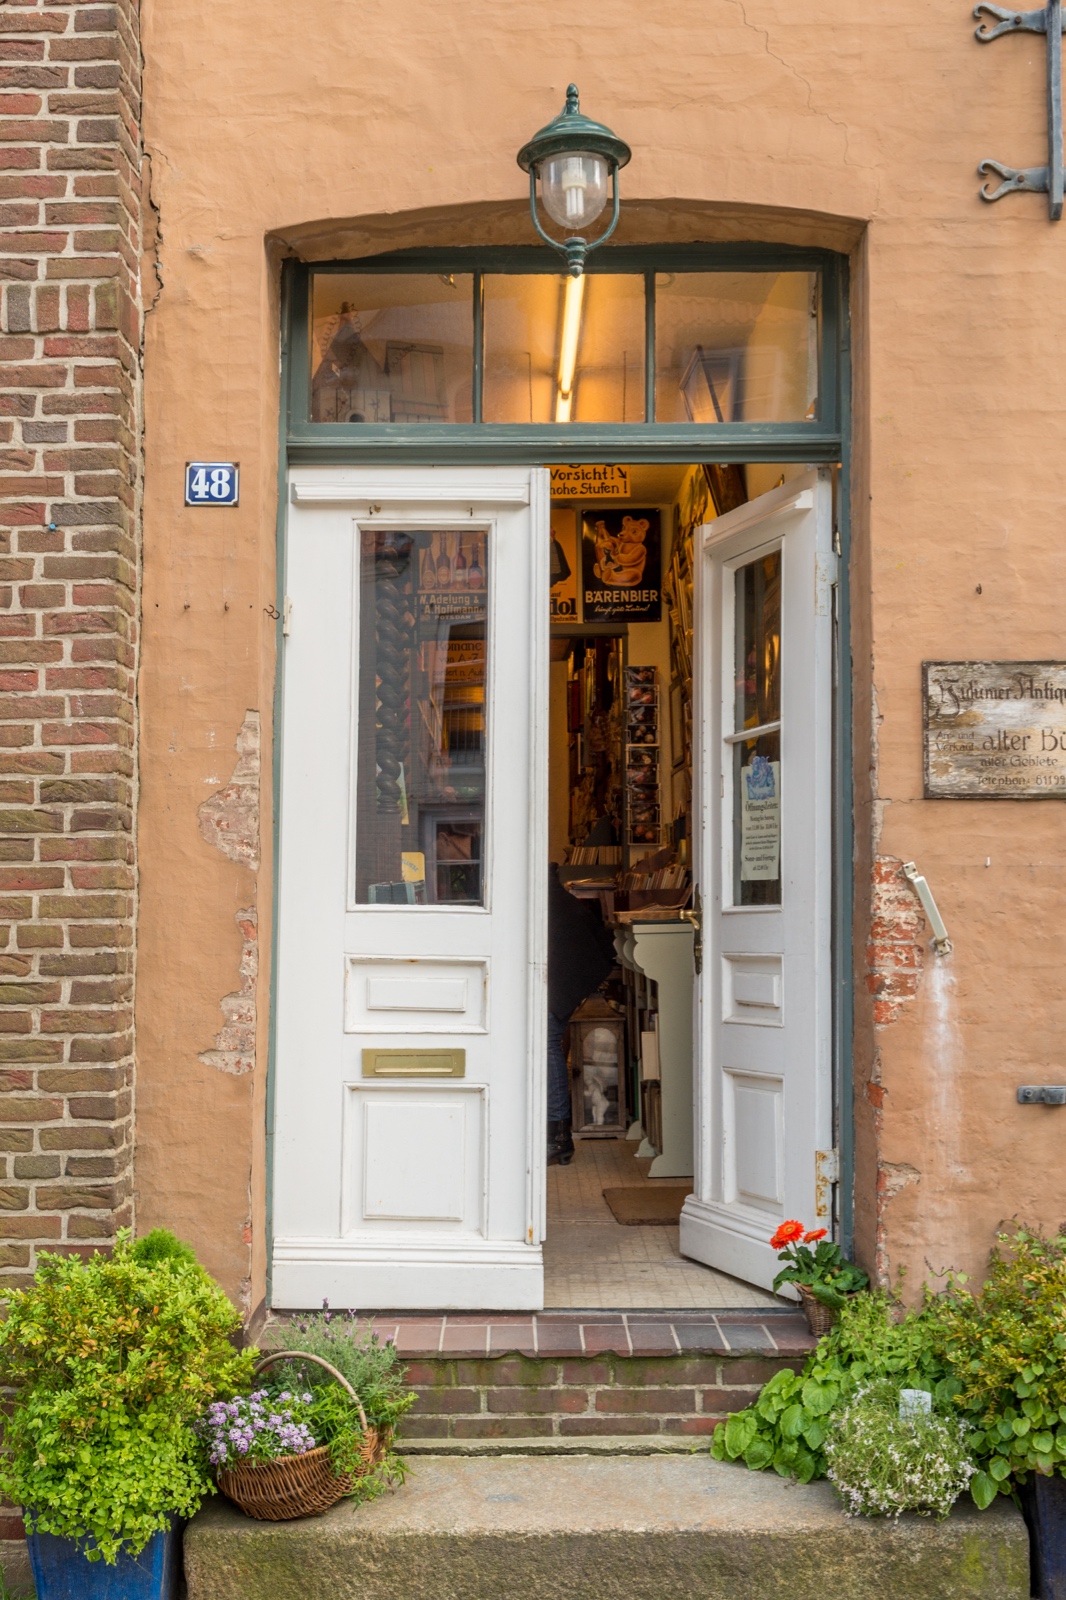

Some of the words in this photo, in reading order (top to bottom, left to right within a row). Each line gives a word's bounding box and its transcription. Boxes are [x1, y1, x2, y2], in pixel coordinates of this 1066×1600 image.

[191, 468, 231, 499] 48
[585, 589, 658, 603] BÄRENBIER
[958, 731, 975, 740] und
[982, 730, 1031, 751] alter
[1010, 755, 1058, 767] Gebiete
